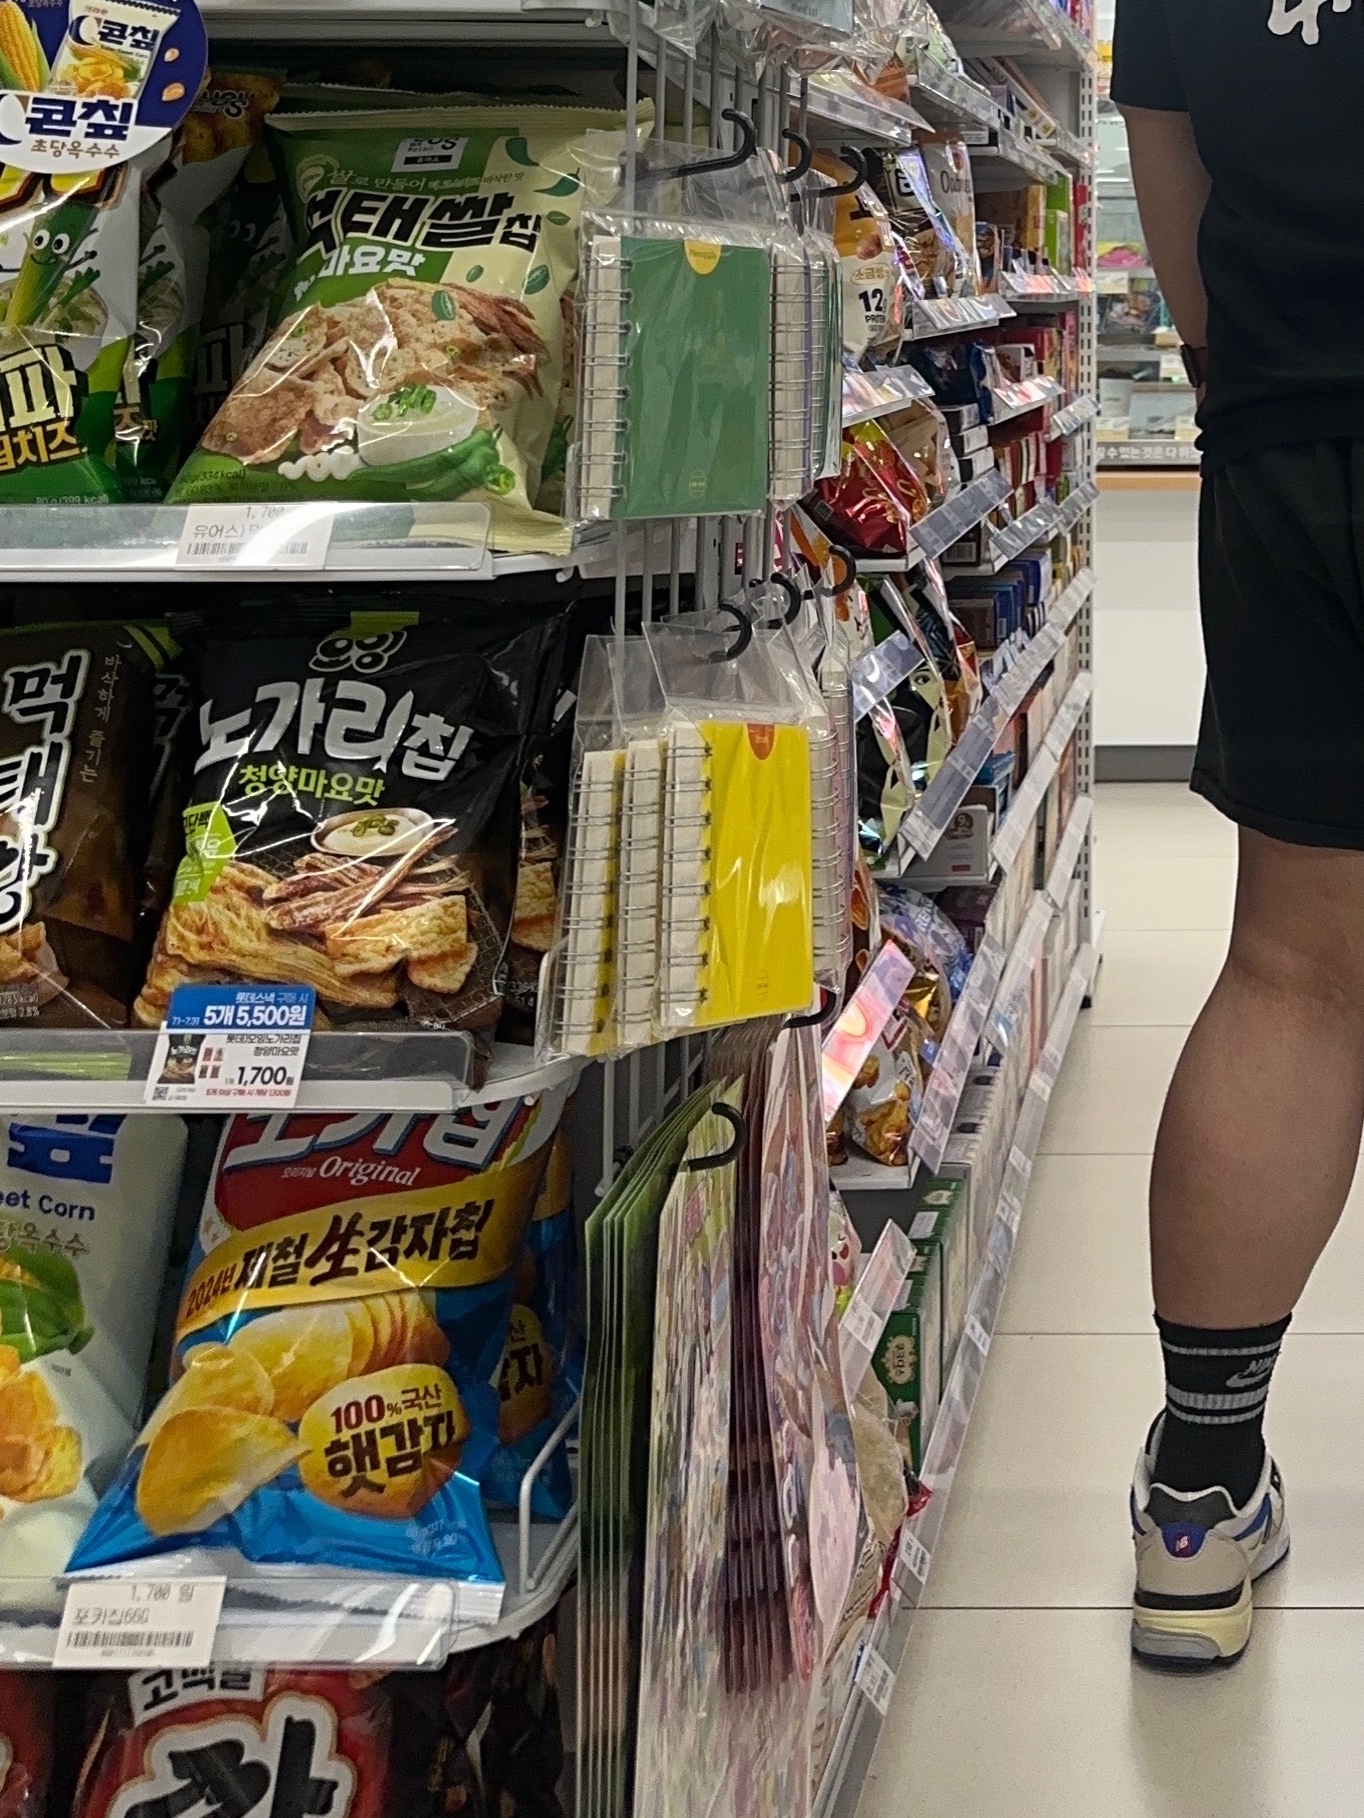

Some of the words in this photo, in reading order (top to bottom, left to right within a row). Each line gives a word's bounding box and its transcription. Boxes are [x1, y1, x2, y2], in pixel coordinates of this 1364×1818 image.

[25, 96, 135, 141] 콘칲
[30, 138, 121, 160] 초당옥수수
[193, 677, 474, 781] 노가리칩
[239, 763, 386, 807] 청양마요맛
[235, 991, 275, 1004] 롯데스낵
[203, 1005, 235, 1026] 5개
[236, 1004, 307, 1027] 5,500원
[319, 1155, 422, 1188] Original
[38, 1194, 96, 1221] Corn
[233, 1232, 309, 1292] 제철
[401, 1384, 443, 1413] 국산
[324, 1409, 456, 1499] 햇감자
[130, 1583, 171, 1603] 1,700
[71, 1606, 150, 1625] 포카칩66G
